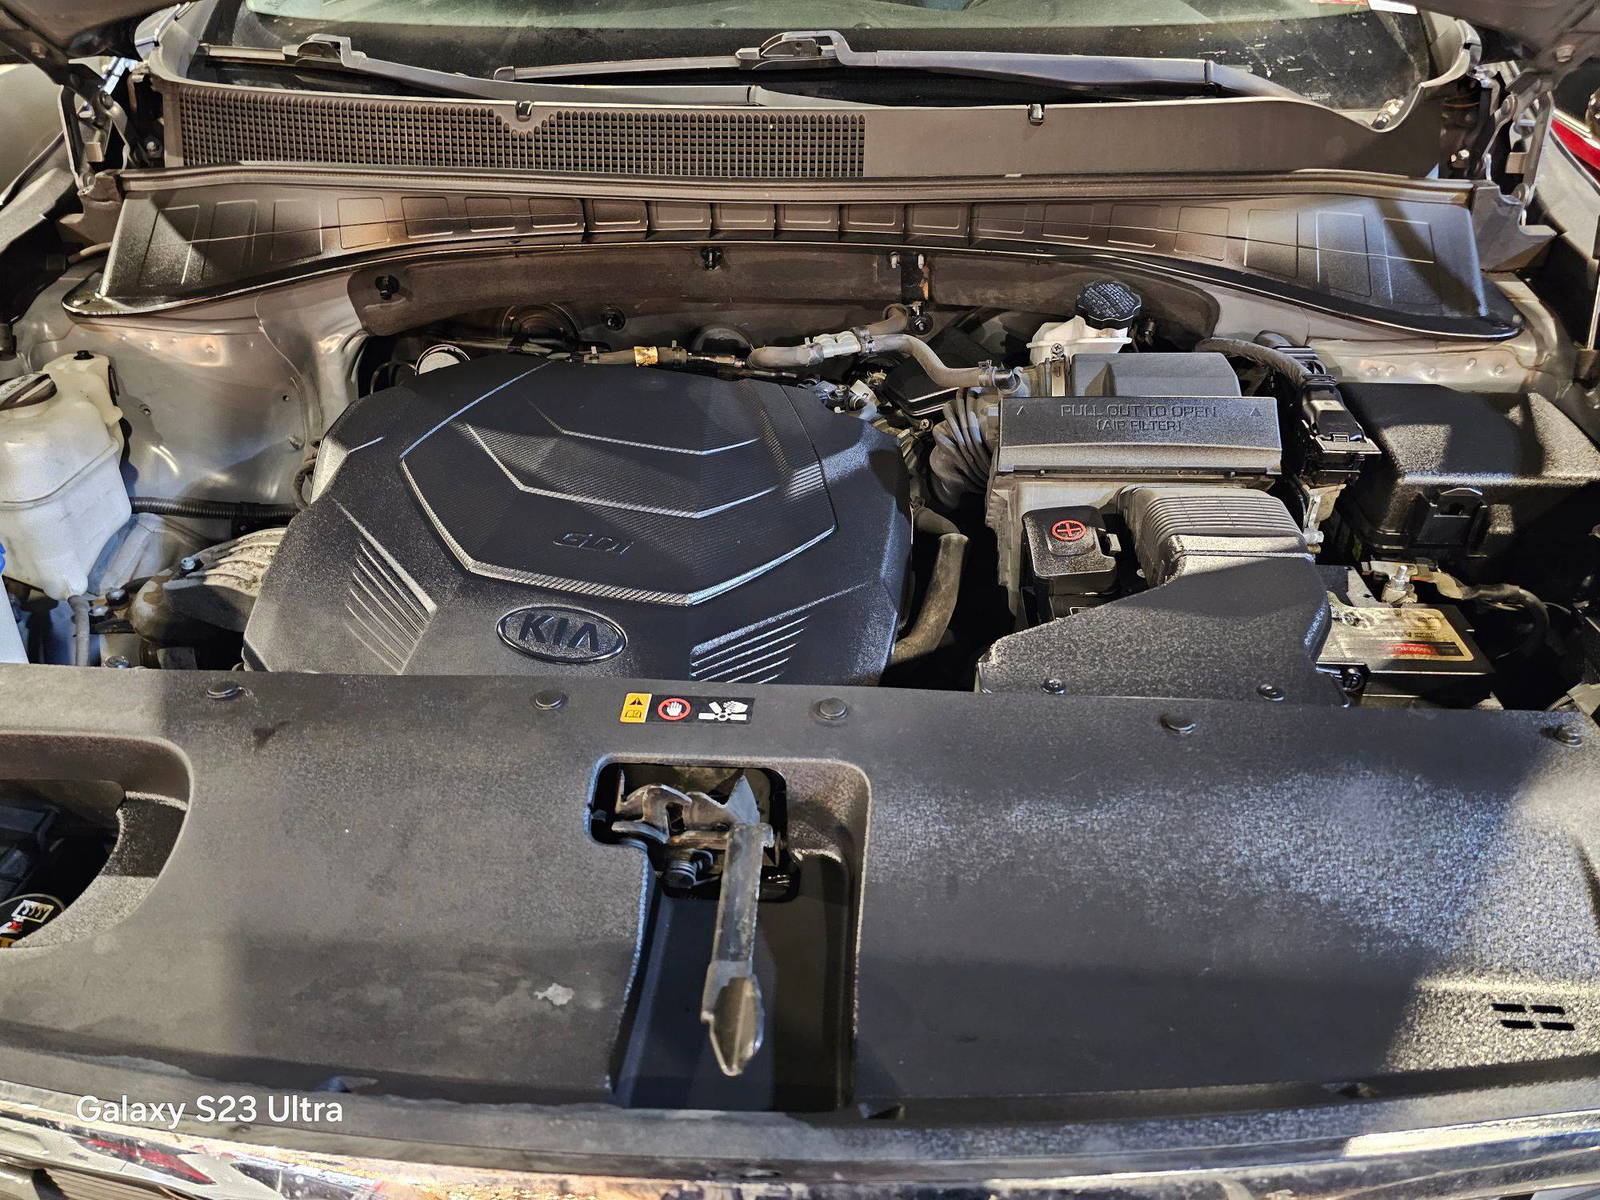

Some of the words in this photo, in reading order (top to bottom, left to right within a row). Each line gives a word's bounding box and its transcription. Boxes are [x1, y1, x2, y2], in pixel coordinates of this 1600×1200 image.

[1060, 403, 1103, 418] PULL
[1106, 403, 1141, 418] OUT
[1146, 404, 1167, 418] TO
[1171, 404, 1216, 418] OPEN
[518, 612, 601, 653] KIA
